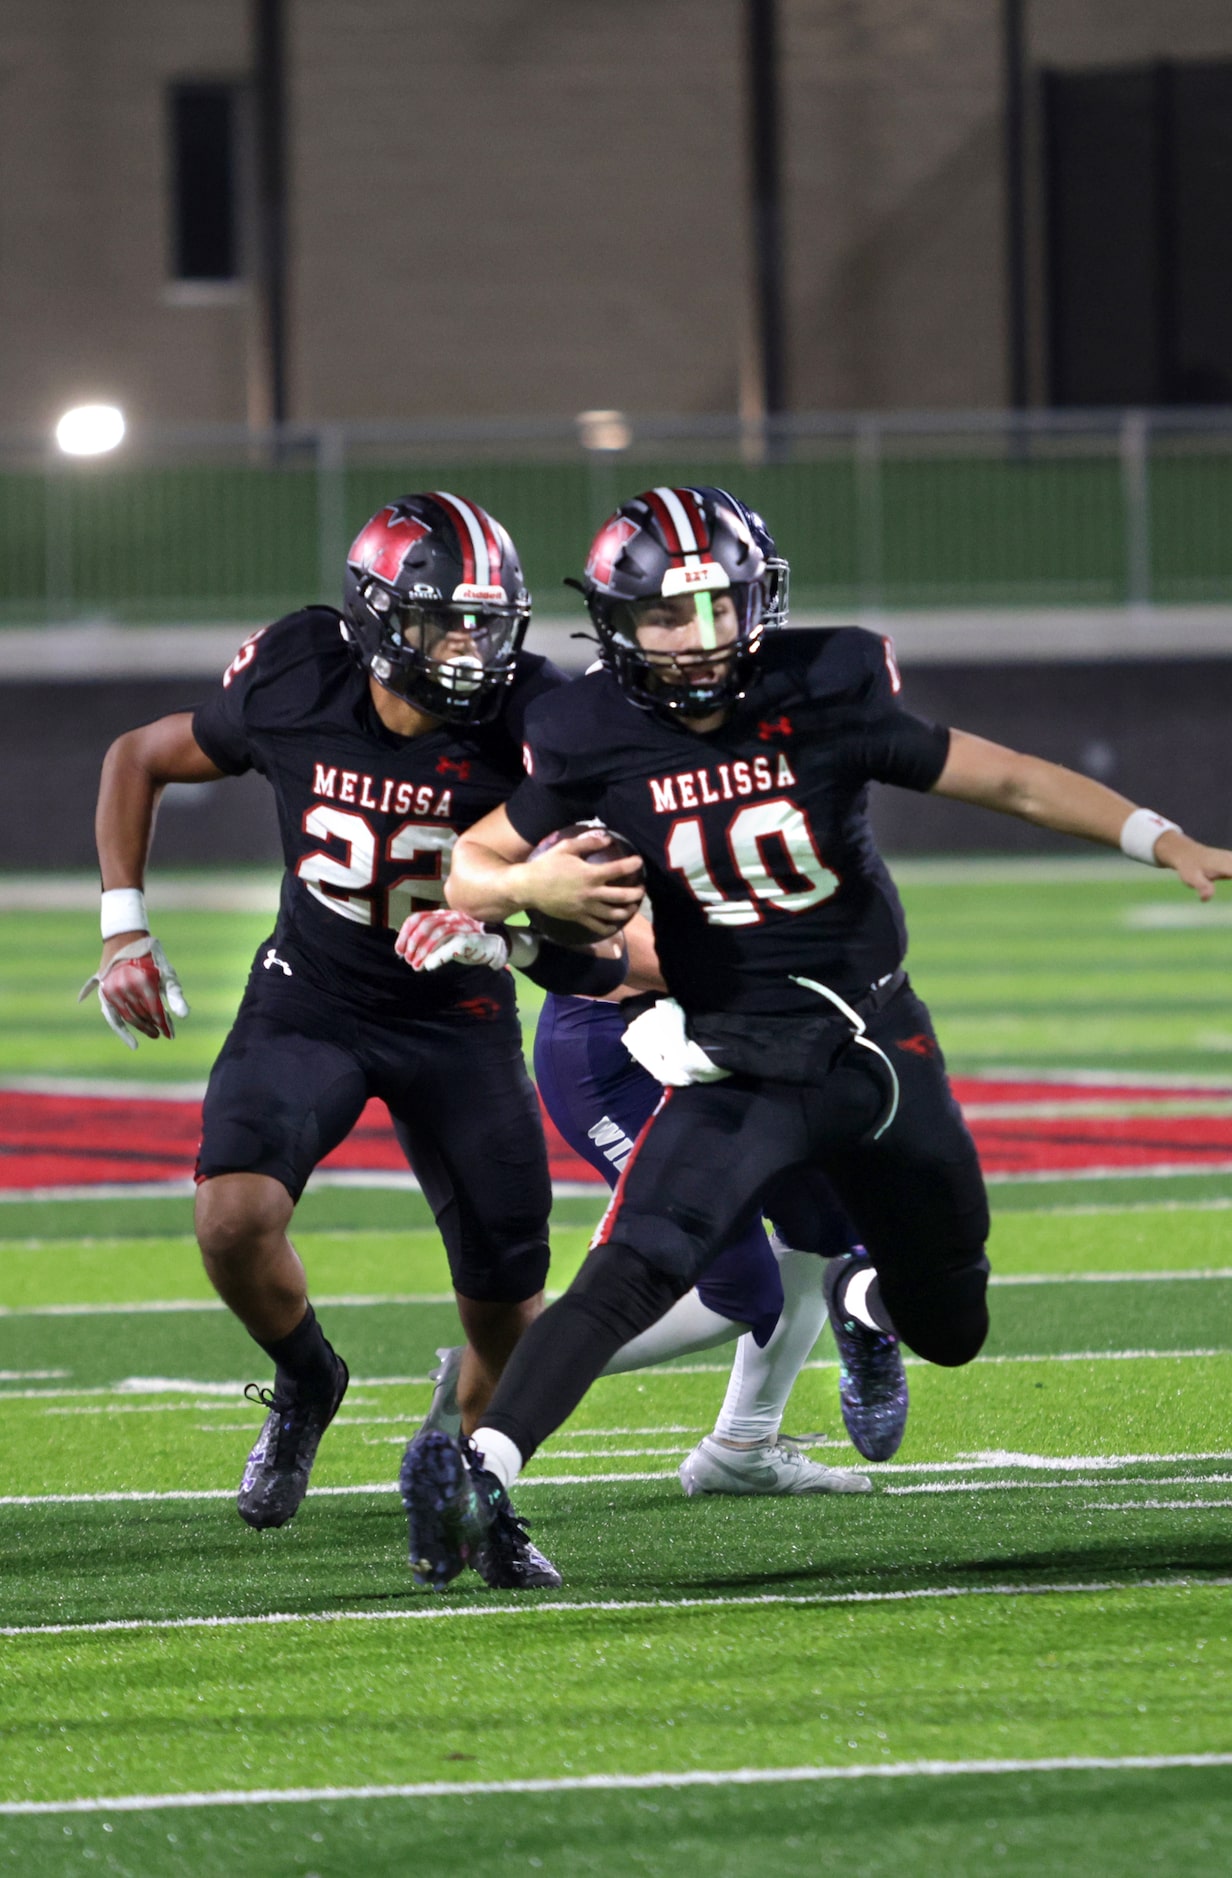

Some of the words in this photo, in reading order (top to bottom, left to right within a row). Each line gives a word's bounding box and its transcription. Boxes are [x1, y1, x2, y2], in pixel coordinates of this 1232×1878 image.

[313, 763, 453, 818] MELISSA
[648, 752, 797, 814] MELISSA
[294, 802, 461, 931] 22
[664, 796, 842, 927] 10
